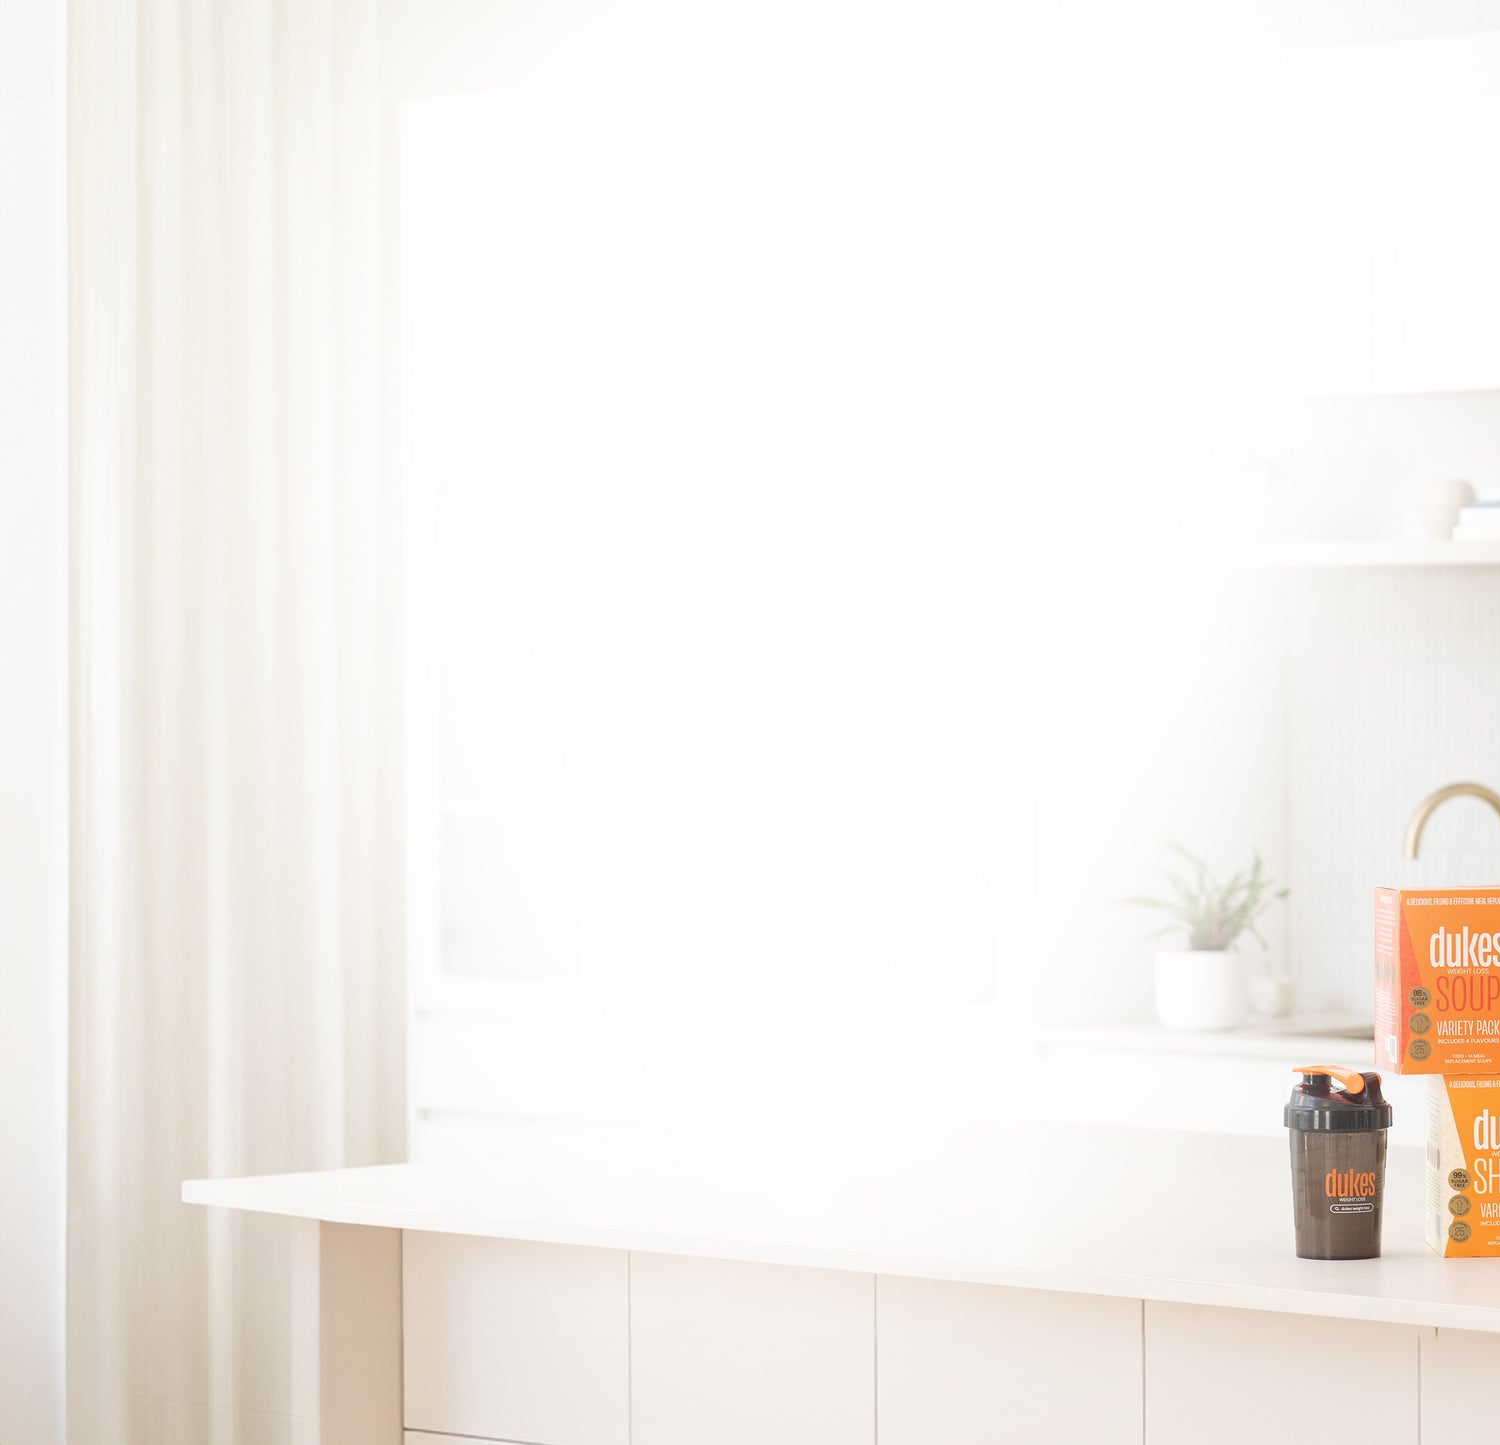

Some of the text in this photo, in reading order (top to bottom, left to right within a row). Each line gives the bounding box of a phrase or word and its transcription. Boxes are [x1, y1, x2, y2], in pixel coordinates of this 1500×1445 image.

[1436, 975, 1500, 1012] SOUP
[1436, 1020, 1474, 1036] VARIETY
[1476, 1020, 1500, 1035] PACK
[1414, 1044, 1424, 1054] 25
[1325, 1168, 1376, 1197] dukes
[1454, 1227, 1464, 1236] 25
